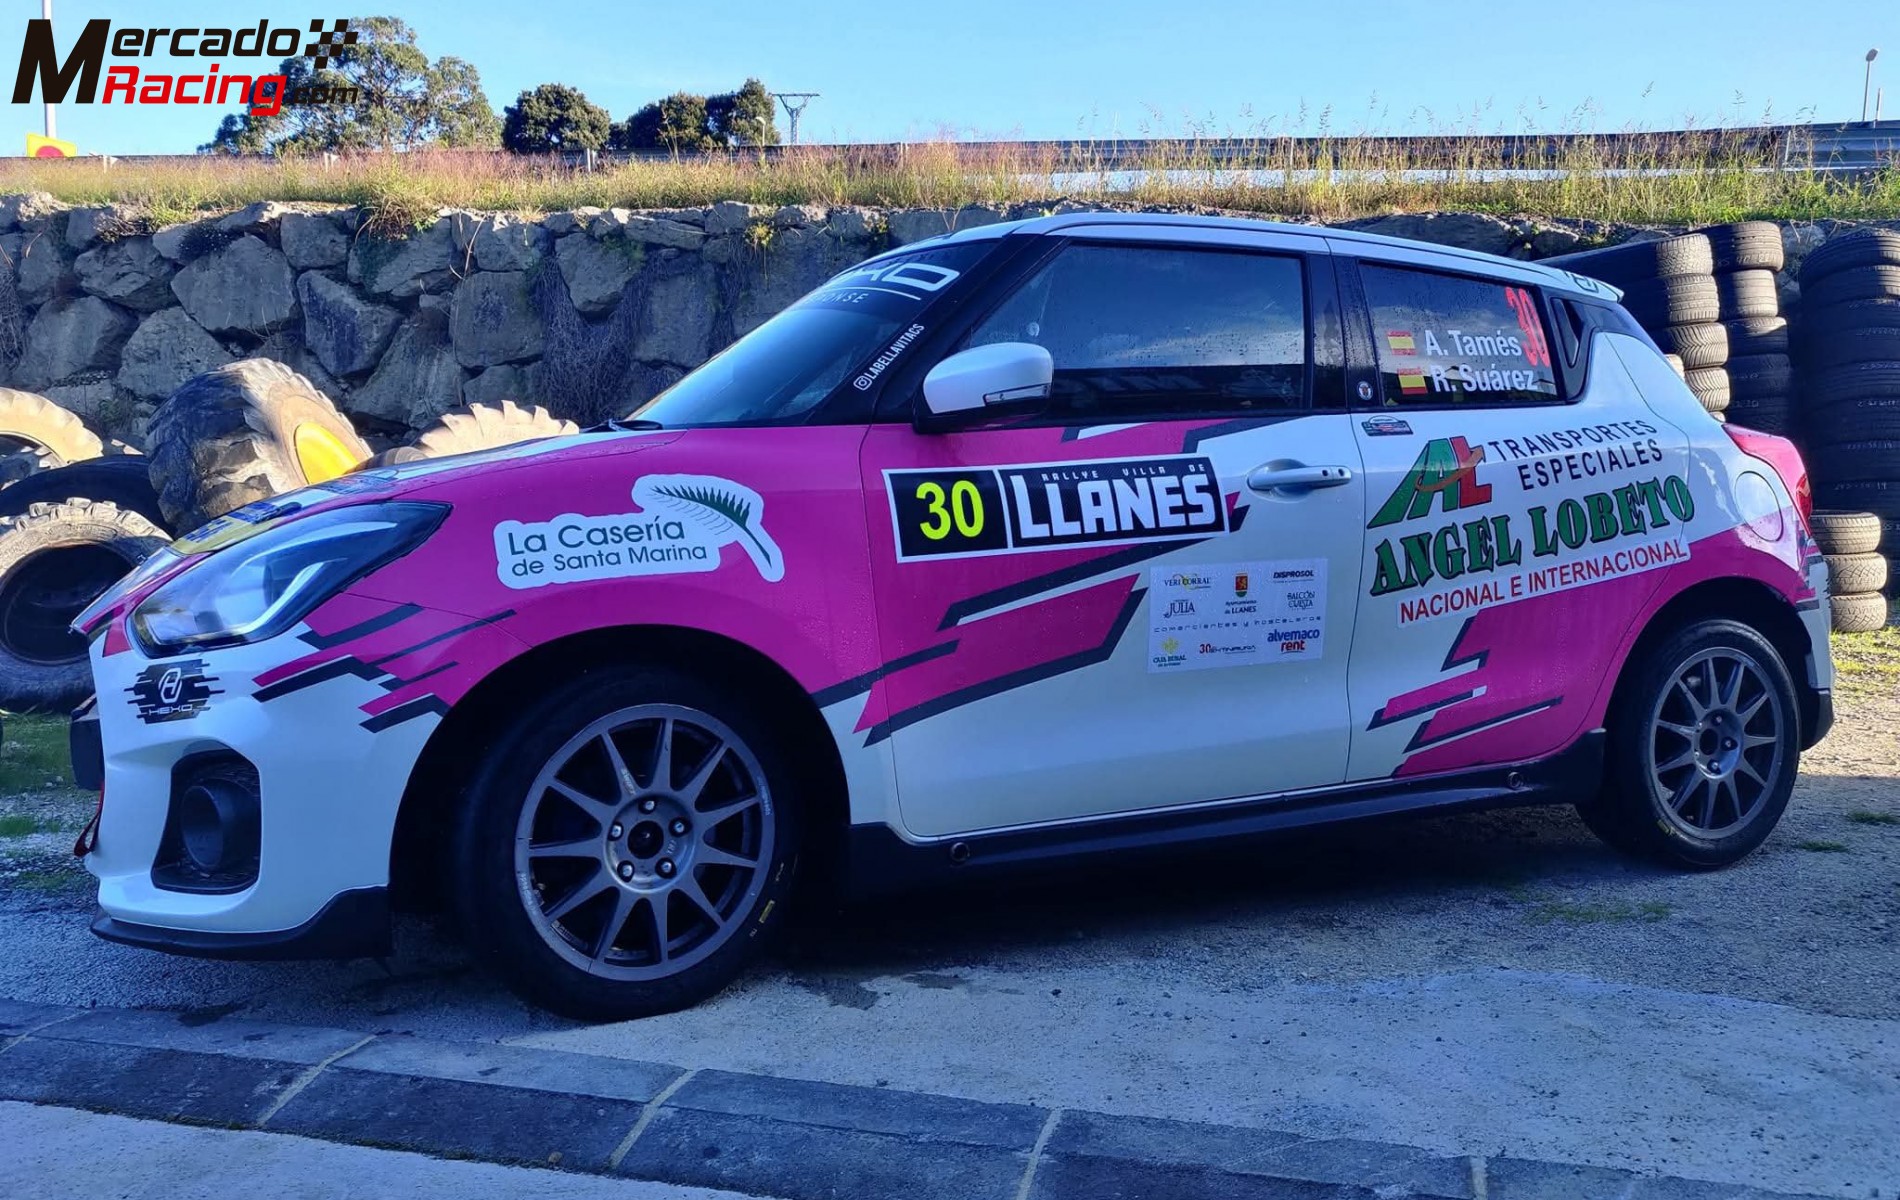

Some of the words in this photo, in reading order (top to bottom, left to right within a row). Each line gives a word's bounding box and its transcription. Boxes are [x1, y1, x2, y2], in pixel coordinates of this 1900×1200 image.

[1424, 329, 1448, 356] A.
[1448, 329, 1522, 356] Tamés
[1430, 364, 1456, 392] R.
[1462, 363, 1539, 392] Suárez
[1487, 419, 1658, 463] TRANSPORTES
[1042, 470, 1099, 482] RALLYE
[1123, 466, 1167, 477] VILLA
[1188, 463, 1206, 473] DE
[1517, 438, 1663, 491] ESPECIALES
[915, 480, 985, 540] 30
[1010, 473, 1217, 540] LLANES
[508, 532, 547, 556] La
[557, 515, 685, 549] Casería
[1370, 514, 1523, 597] ANGEL
[1527, 474, 1696, 557] LOBETO
[511, 558, 545, 577] de
[554, 550, 622, 572] Santa
[628, 544, 708, 563] Marina
[1400, 584, 1506, 624] NACIONAL
[1510, 575, 1522, 597] E
[1529, 539, 1688, 592] INTERNACIONAL
[1267, 629, 1321, 642] alvemaco
[1281, 640, 1305, 652] rent
